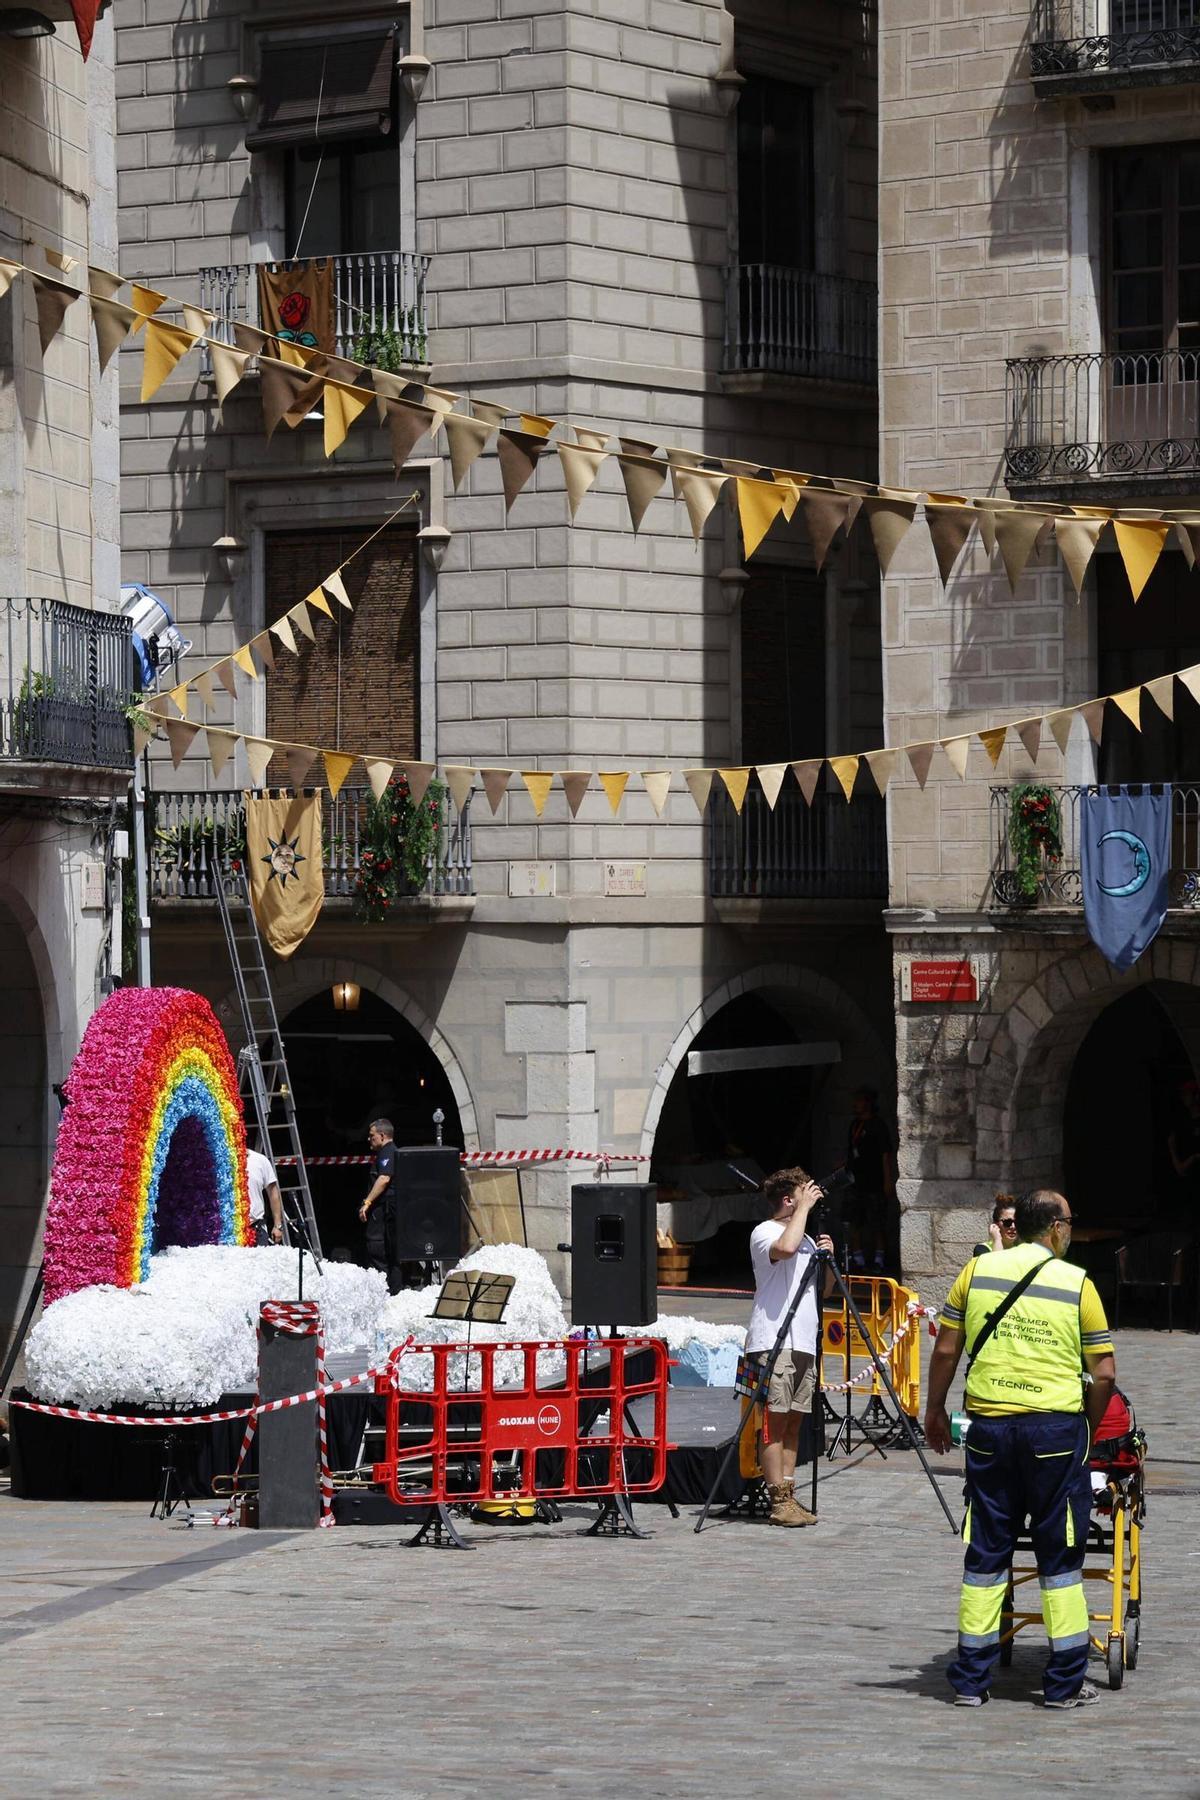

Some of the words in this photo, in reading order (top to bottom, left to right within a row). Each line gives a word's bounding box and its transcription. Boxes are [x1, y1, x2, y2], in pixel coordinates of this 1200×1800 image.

[1000, 1321, 1053, 1336] SERVICIOS
[1000, 1330, 1059, 1346] SANITARIOS
[990, 1377, 1043, 1393] TÉCNICO
[540, 1416, 559, 1424] HUNE
